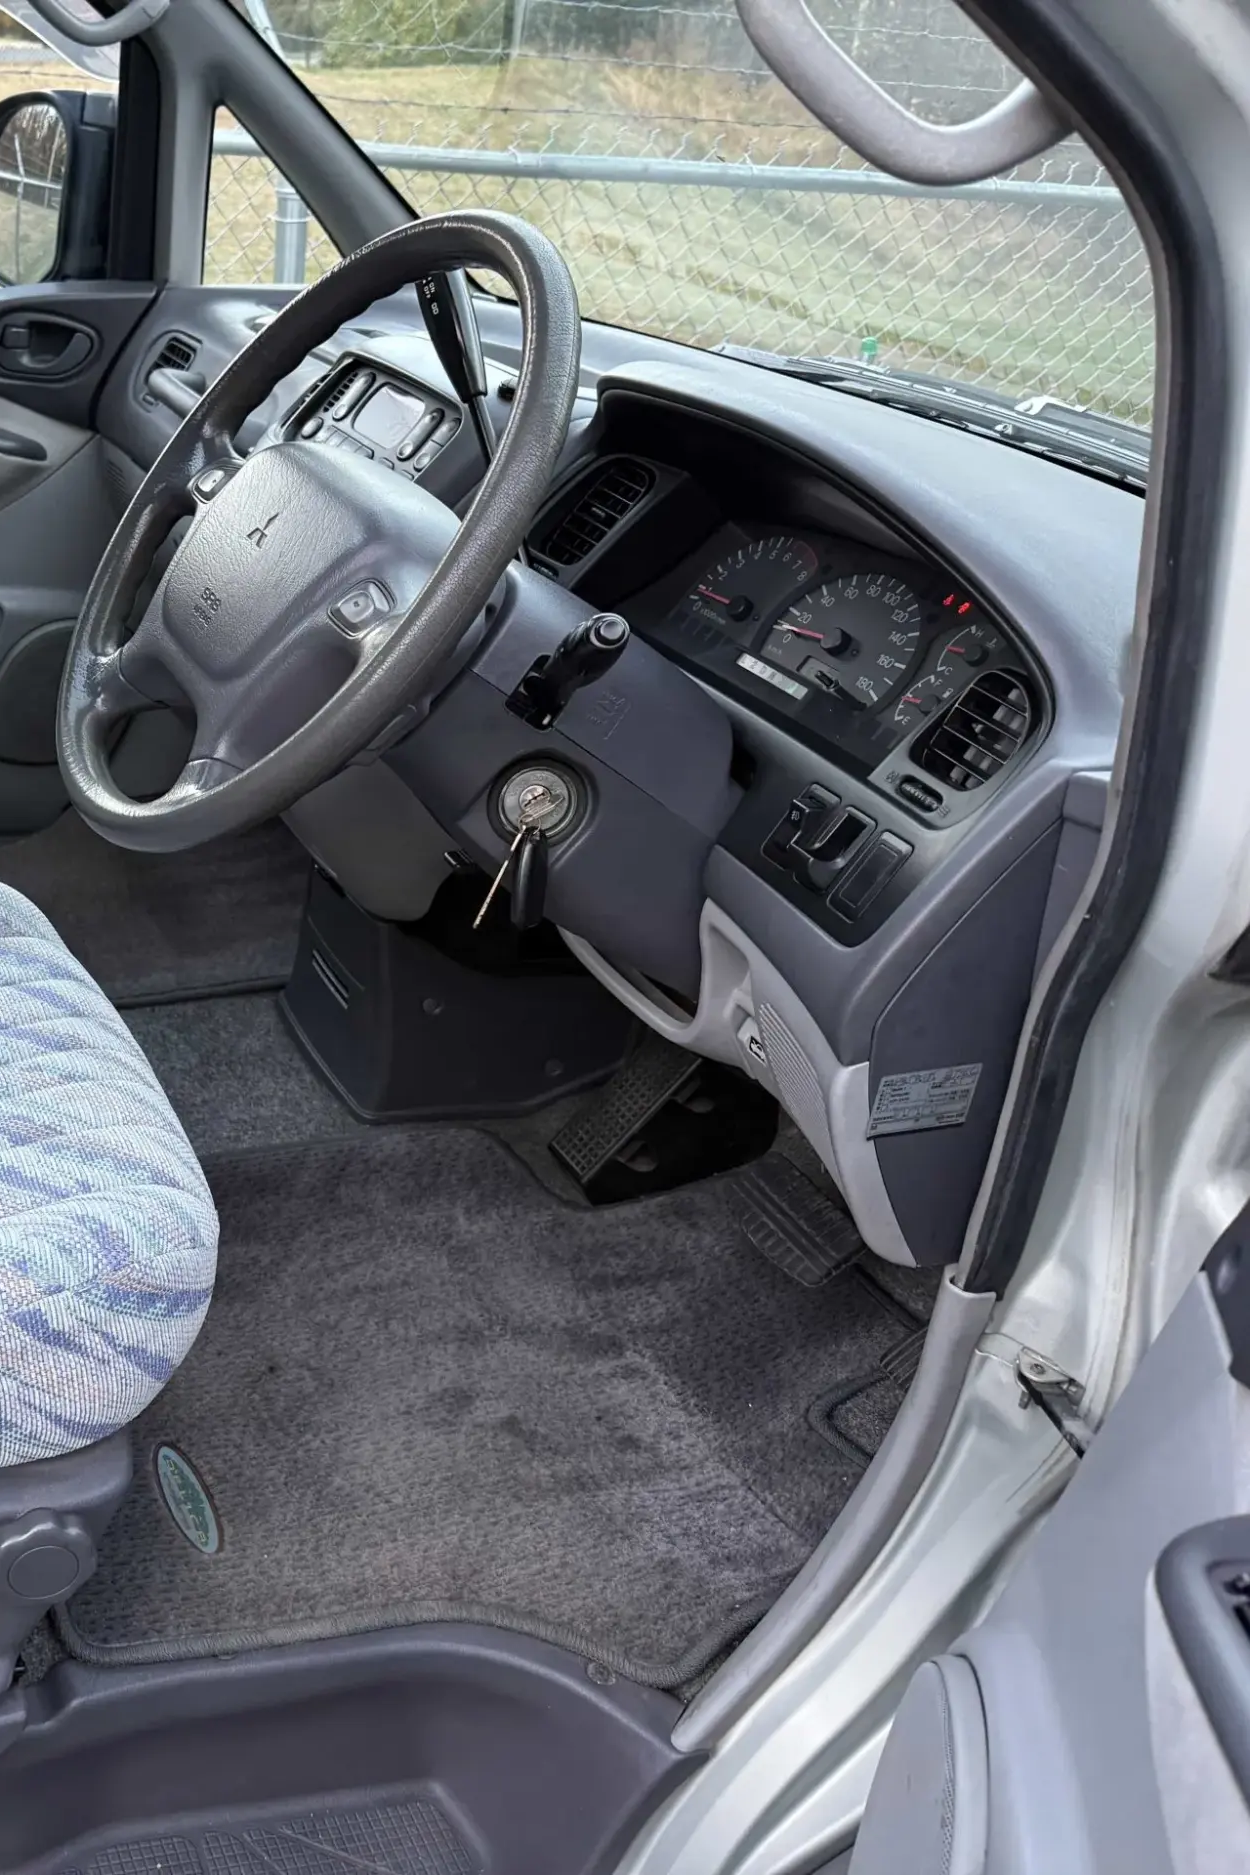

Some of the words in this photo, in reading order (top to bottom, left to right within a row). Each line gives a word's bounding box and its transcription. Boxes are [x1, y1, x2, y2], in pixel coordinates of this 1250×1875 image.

[769, 550, 778, 559] 5
[782, 552, 792, 562] 6
[736, 559, 746, 569] 3
[792, 559, 802, 569] 7
[718, 570, 728, 581] 2
[797, 571, 807, 581] 8
[844, 587, 859, 599] 60
[866, 585, 881, 597] 80
[821, 595, 835, 607] 40
[882, 592, 901, 606] 100
[693, 601, 702, 611] 0
[797, 611, 812, 624] 20
[891, 609, 908, 623] 120
[782, 634, 792, 643] 0
[888, 631, 907, 645] 140
[975, 629, 985, 638] H
[876, 654, 894, 668] 160
[944, 667, 953, 675] C
[855, 676, 873, 691] 180
[933, 679, 942, 687] F
[901, 716, 911, 725] E
